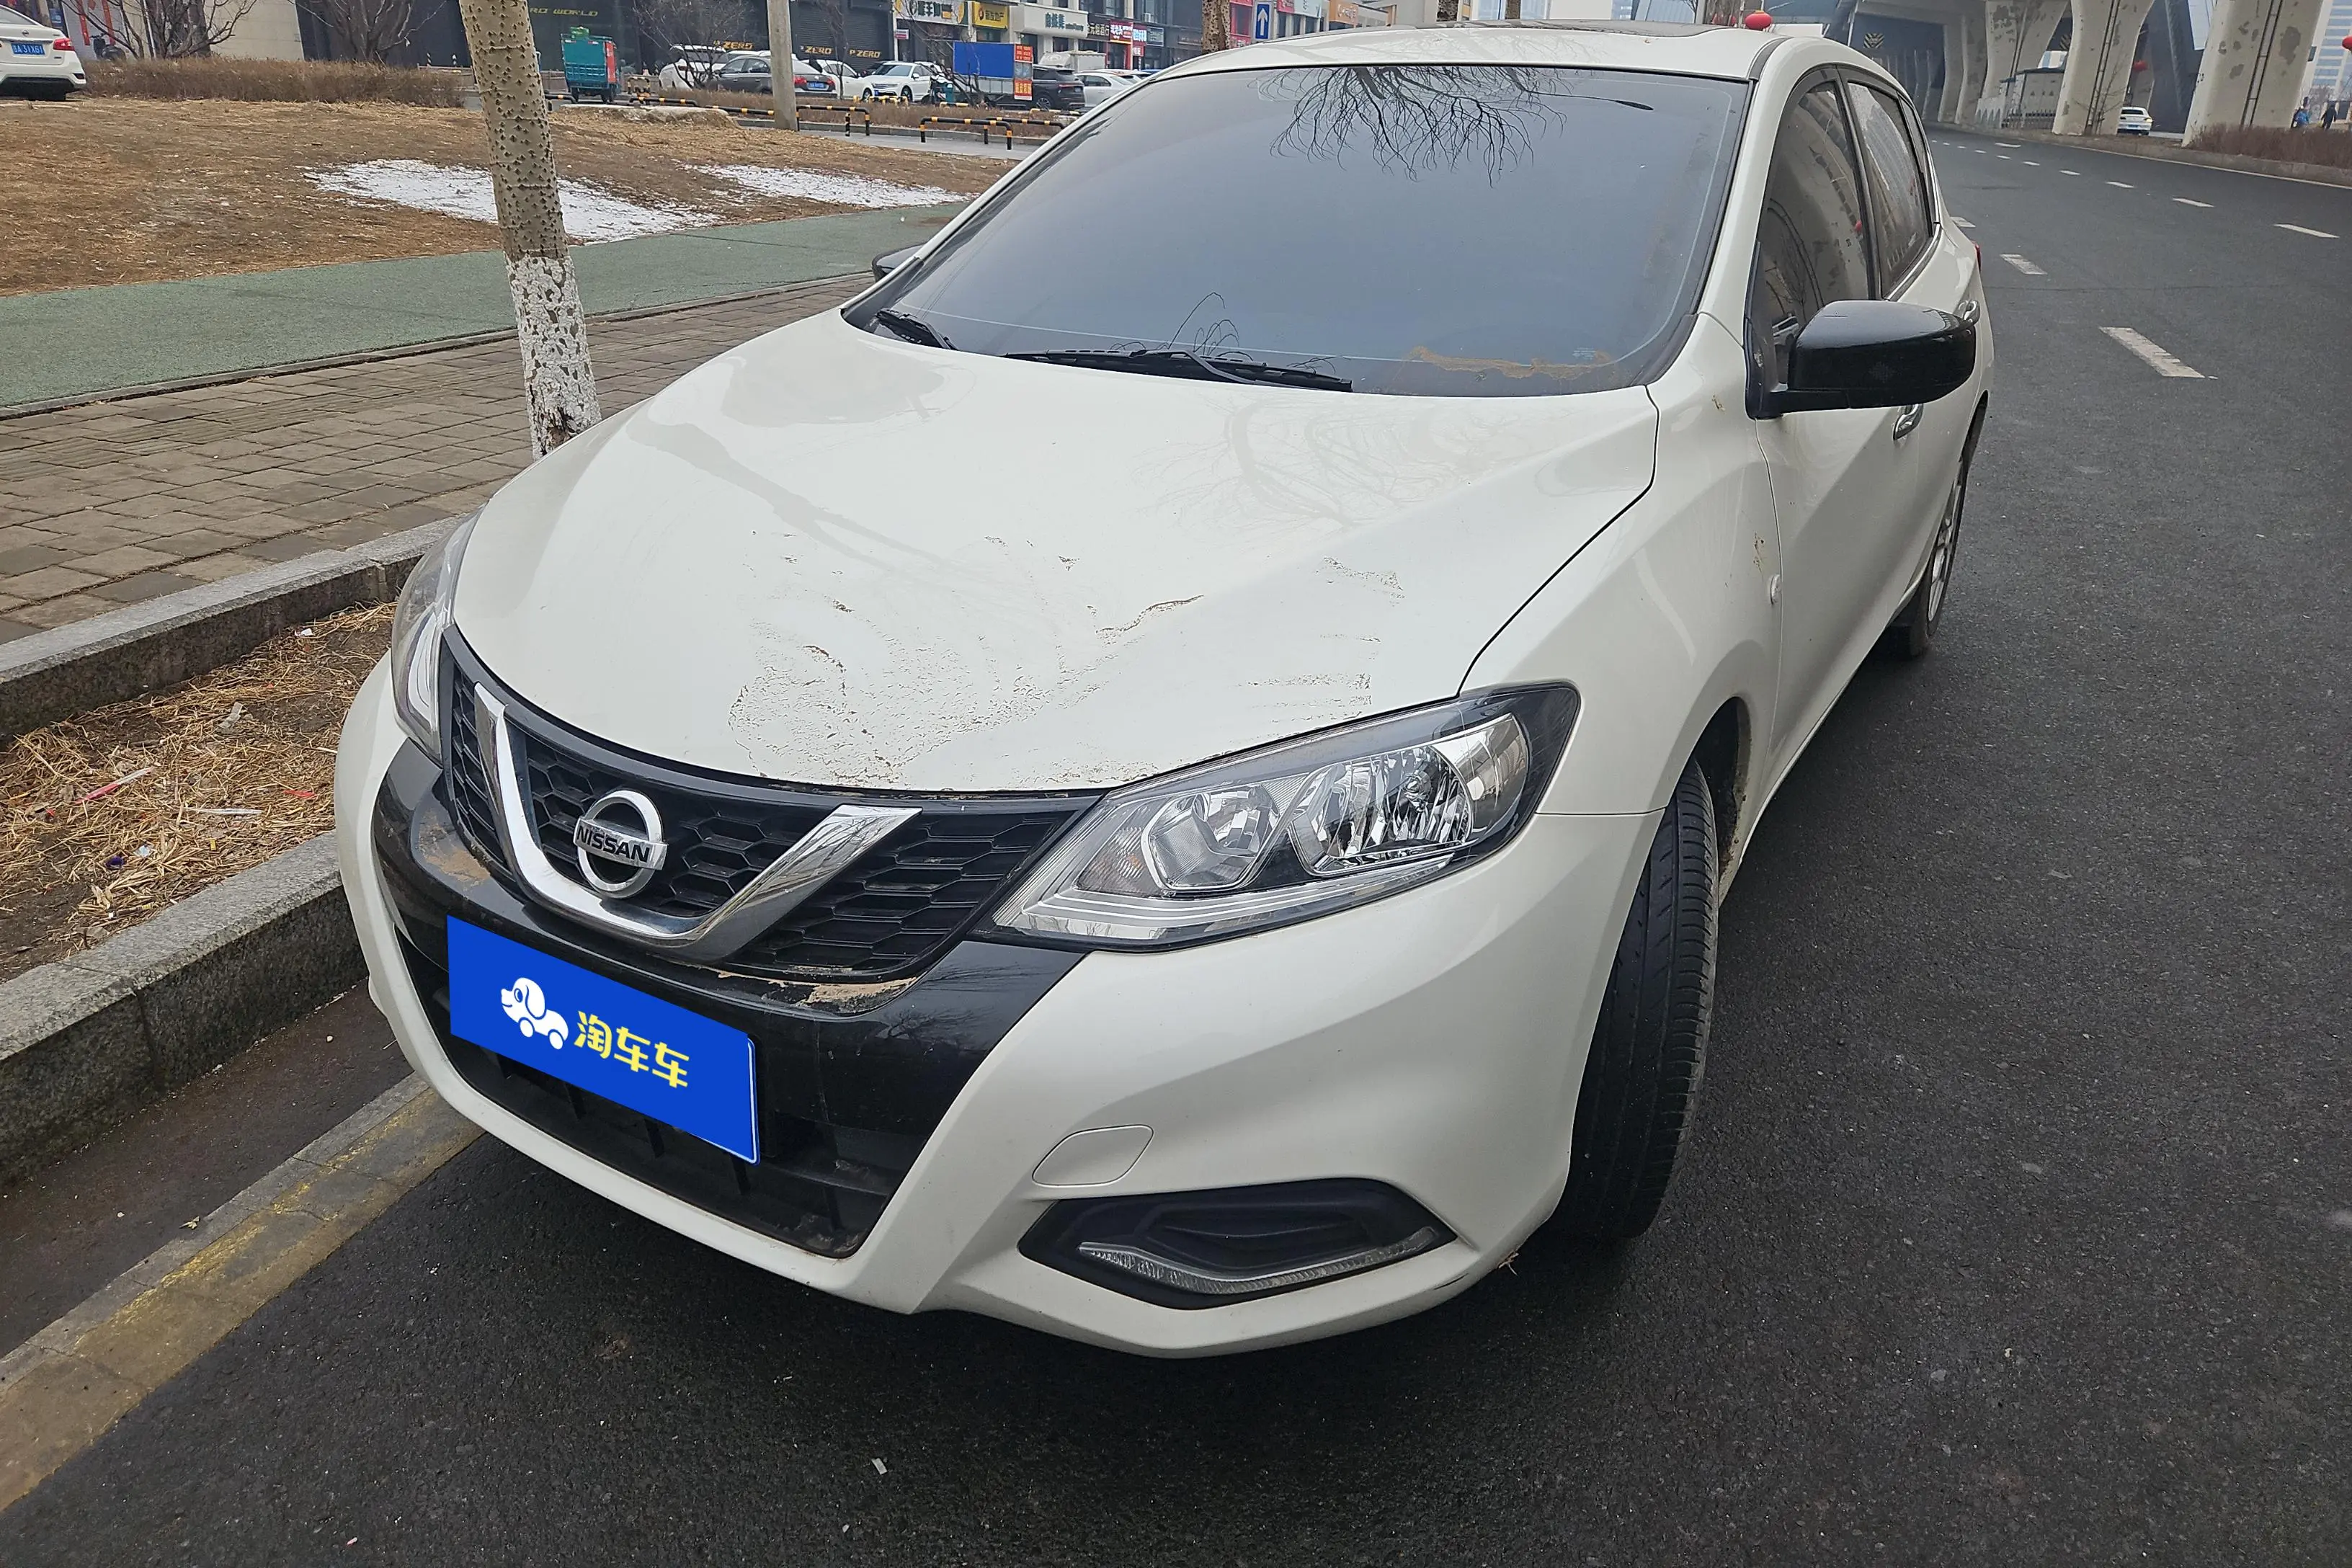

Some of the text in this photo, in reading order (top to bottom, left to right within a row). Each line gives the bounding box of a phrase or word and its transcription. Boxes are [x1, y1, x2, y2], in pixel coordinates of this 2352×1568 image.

[553, 9, 598, 17] WORLD
[805, 45, 832, 55] ZERO
[856, 50, 881, 58] ZERO
[576, 825, 650, 863] NISSAN
